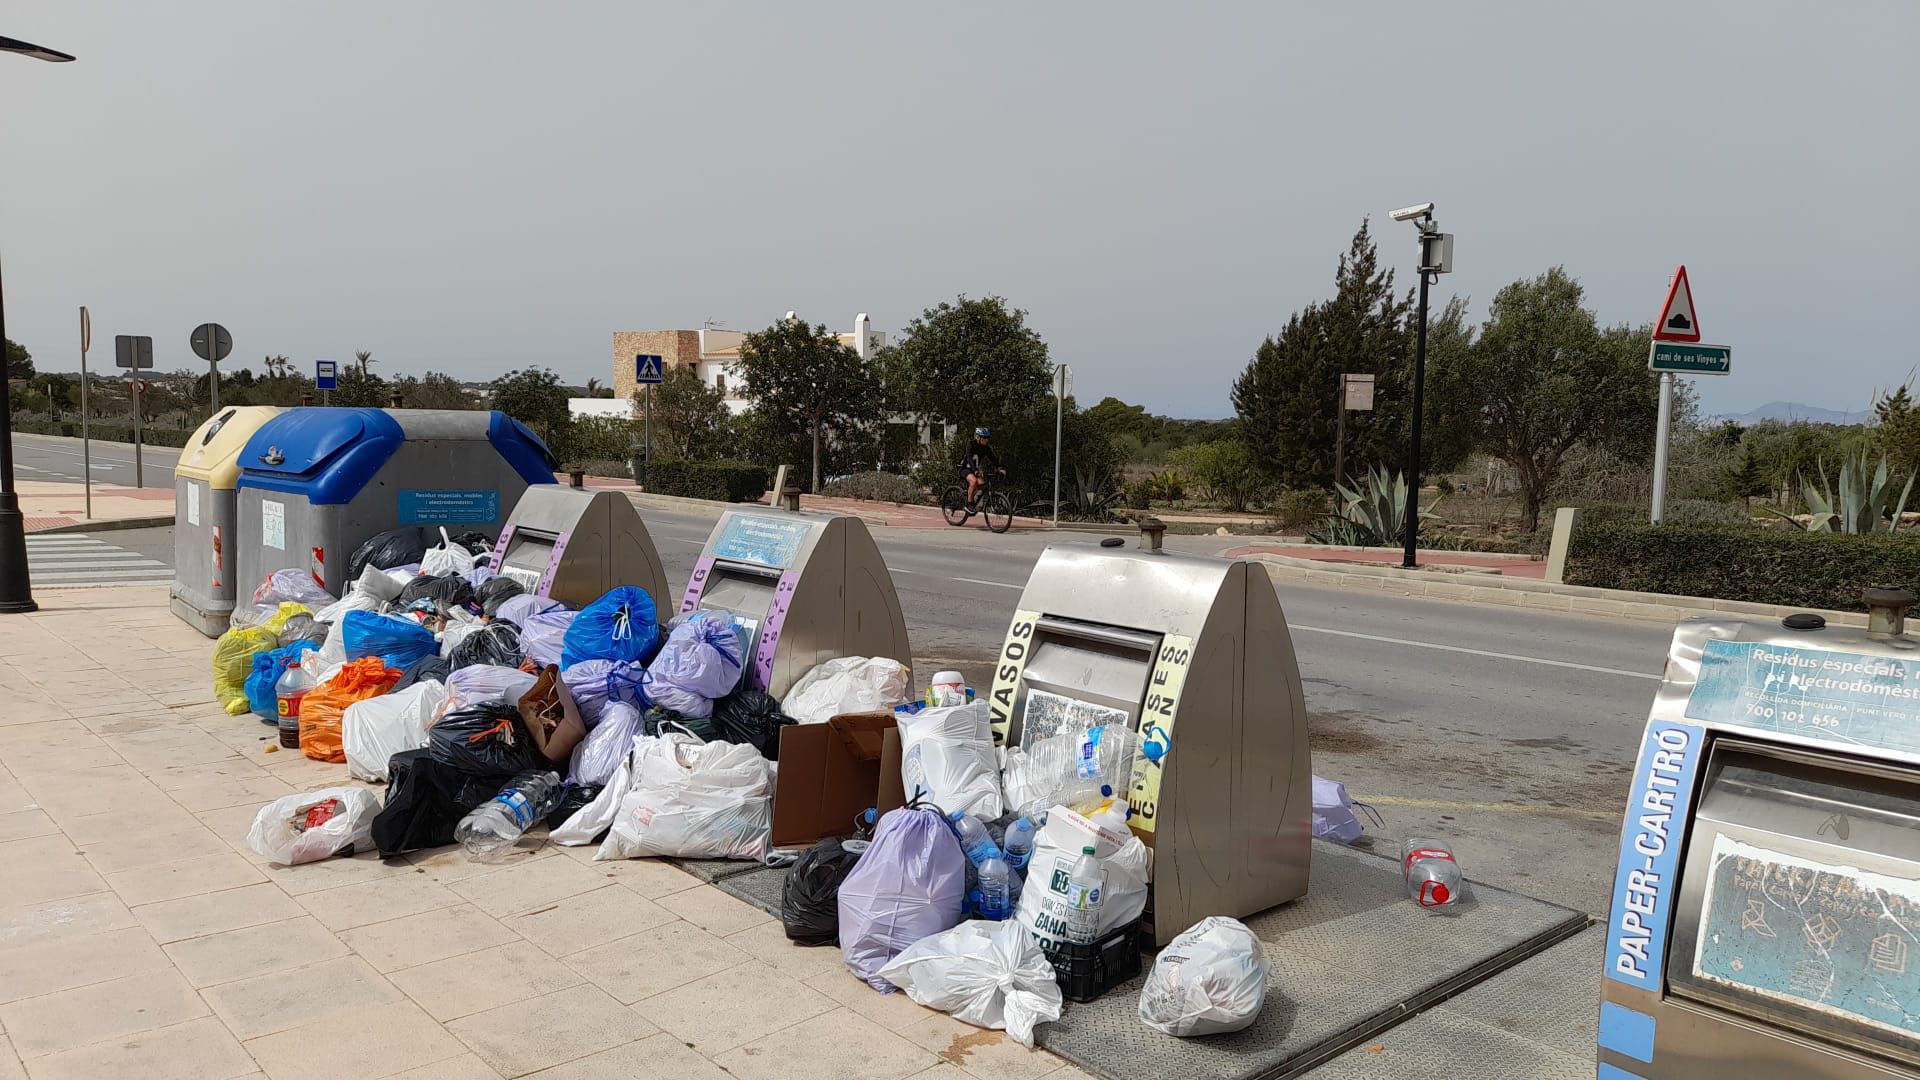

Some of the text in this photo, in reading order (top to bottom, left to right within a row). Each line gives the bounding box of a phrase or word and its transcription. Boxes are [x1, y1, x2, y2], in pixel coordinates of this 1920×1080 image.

[1673, 352, 1682, 361] de
[1683, 354, 1695, 363] ses
[1696, 353, 1717, 365] Vinyes
[1753, 649, 1817, 668] Residus
[1823, 659, 1908, 681] especials,
[1812, 714, 1840, 727] 656
[1617, 728, 1691, 981] PAPER-CARTRÓ
